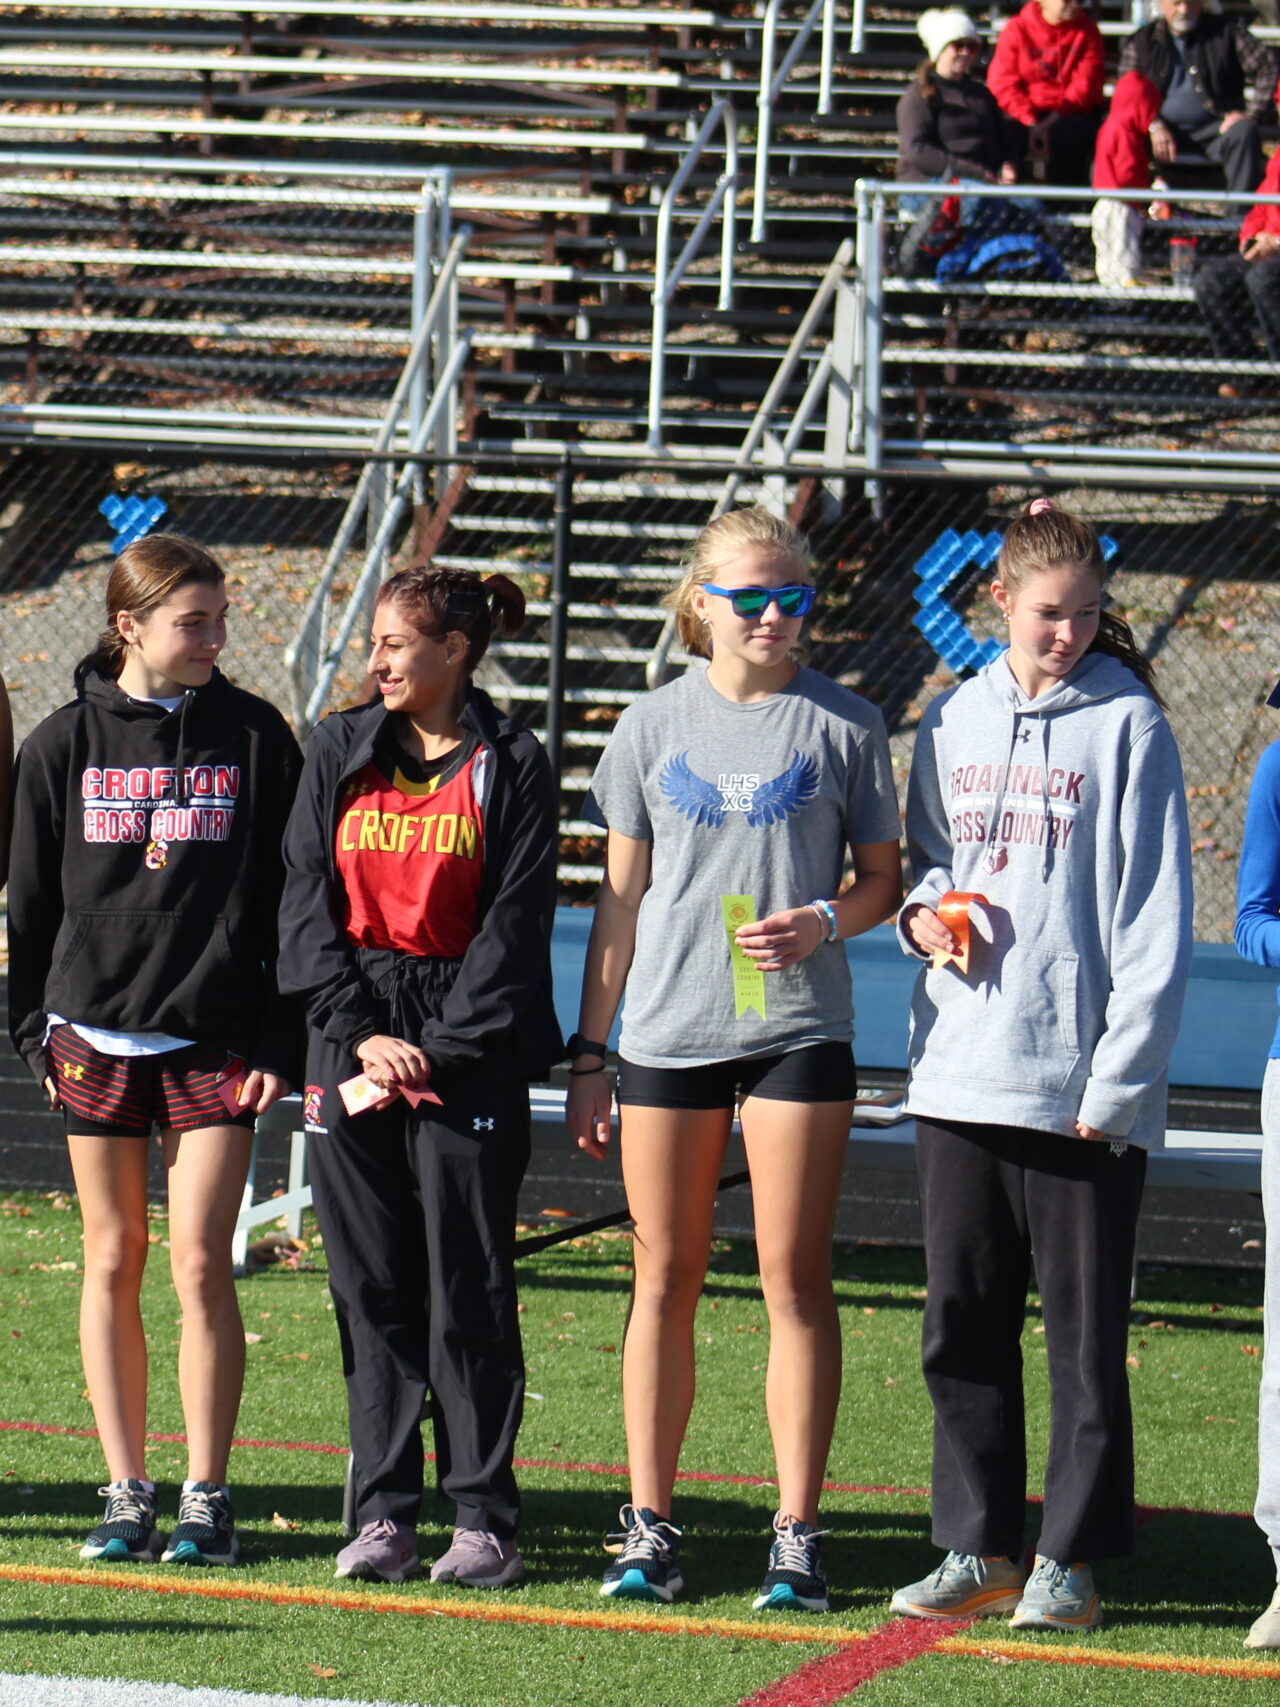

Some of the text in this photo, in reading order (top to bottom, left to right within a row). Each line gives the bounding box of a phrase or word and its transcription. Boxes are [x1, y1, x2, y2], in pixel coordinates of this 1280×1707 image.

[82, 765, 240, 800] CROFTON
[717, 774, 759, 791] LHS
[134, 799, 187, 809] CARDINA
[721, 791, 753, 811] XC
[974, 797, 1025, 808] BRINS
[83, 808, 235, 843] CROSS COUNTRY
[341, 810, 477, 859] CROFTON
[994, 811, 1074, 850] OUNTRY
